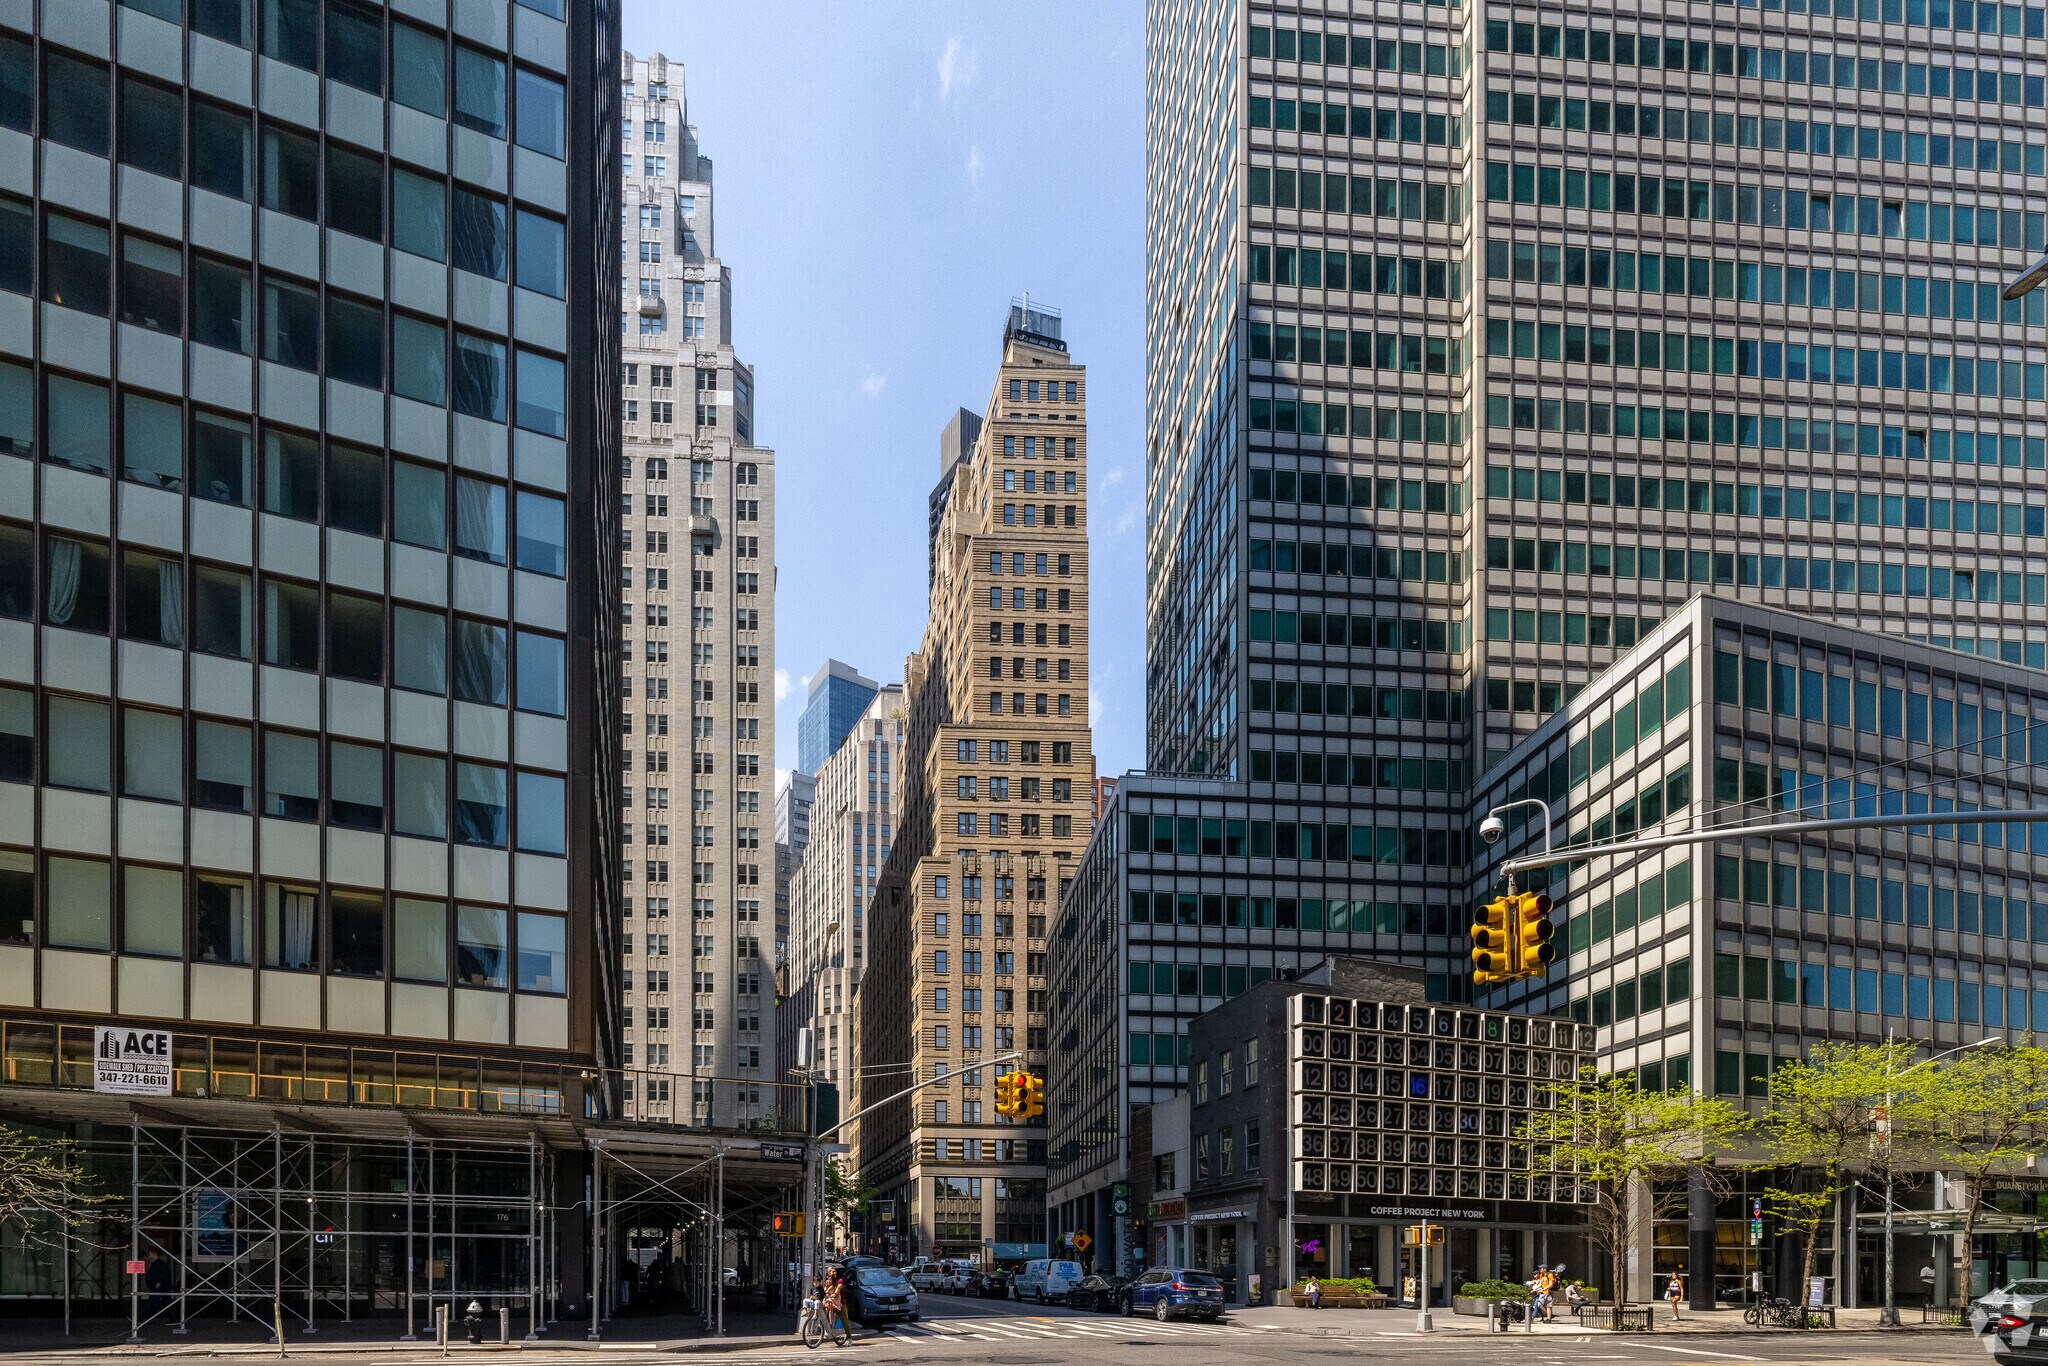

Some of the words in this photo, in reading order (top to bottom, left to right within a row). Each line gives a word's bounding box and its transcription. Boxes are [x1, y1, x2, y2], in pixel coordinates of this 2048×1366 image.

[1310, 1001, 1316, 1019] 1
[1333, 1003, 1345, 1022] 2
[1361, 1007, 1371, 1024] 3
[1387, 1010, 1398, 1027] 4
[1413, 1012, 1424, 1030] 5
[1438, 1015, 1449, 1033] 6
[1463, 1018, 1473, 1035] 7
[1487, 1021, 1498, 1038] 8
[1511, 1023, 1521, 1040] 9
[1532, 1025, 1547, 1043] 10
[1558, 1028, 1568, 1045] 11
[1579, 1030, 1594, 1047] 12
[123, 1032, 168, 1056] ACE
[1303, 1034, 1323, 1053] 00
[1331, 1037, 1348, 1055] 01
[1357, 1040, 1377, 1058] 02
[1384, 1042, 1403, 1060] 03
[1410, 1044, 1428, 1063] 04
[1435, 1047, 1453, 1065] 05
[1460, 1049, 1478, 1067] 06
[1485, 1051, 1503, 1069] 07
[1509, 1054, 1526, 1072] 08
[1532, 1056, 1550, 1073] 09
[1556, 1059, 1571, 1076] 10
[100, 1072, 168, 1085] 347-221-6610
[136, 1064, 147, 1072] PIPE
[147, 1065, 168, 1074] SCAFFOLD
[1304, 1068, 1321, 1086] 12
[1331, 1070, 1348, 1088] 13
[1358, 1072, 1375, 1090] 14
[1384, 1074, 1401, 1092] 15
[1410, 1076, 1427, 1096] 16
[1436, 1078, 1452, 1096] 17
[1461, 1081, 1476, 1099] 18
[1485, 1083, 1501, 1100] 19
[1509, 1085, 1526, 1103] 20
[1303, 1101, 1323, 1120] 24
[1330, 1103, 1350, 1121] 25
[1357, 1105, 1377, 1123] 26
[1384, 1107, 1403, 1125] 27
[1410, 1109, 1428, 1127] 28
[1435, 1111, 1453, 1128] 29
[1460, 1112, 1478, 1130] 30
[1485, 1114, 1500, 1132] 31
[764, 1148, 783, 1158] Water
[1303, 1134, 1323, 1153] 36
[1330, 1136, 1350, 1154] 37
[1357, 1138, 1377, 1156] 38
[1384, 1140, 1403, 1157] 39
[1410, 1141, 1428, 1159] 40
[1436, 1143, 1452, 1160] 41
[1460, 1145, 1478, 1162] 42
[1485, 1146, 1503, 1163] 43
[1303, 1167, 1323, 1186] 48
[1331, 1169, 1350, 1187] 49
[1357, 1171, 1377, 1188] 50
[1385, 1172, 1400, 1190] 51
[1410, 1173, 1428, 1191] 52
[1436, 1175, 1453, 1192] 53
[1460, 1176, 1479, 1194] 54
[1485, 1178, 1503, 1195] 55
[1509, 1179, 1526, 1195] 56
[497, 1213, 509, 1221] 176
[1370, 1206, 1403, 1215] COFFEE
[1404, 1208, 1440, 1217] PROJECT
[1441, 1209, 1461, 1218] NEW
[1462, 1210, 1485, 1219] YORK
